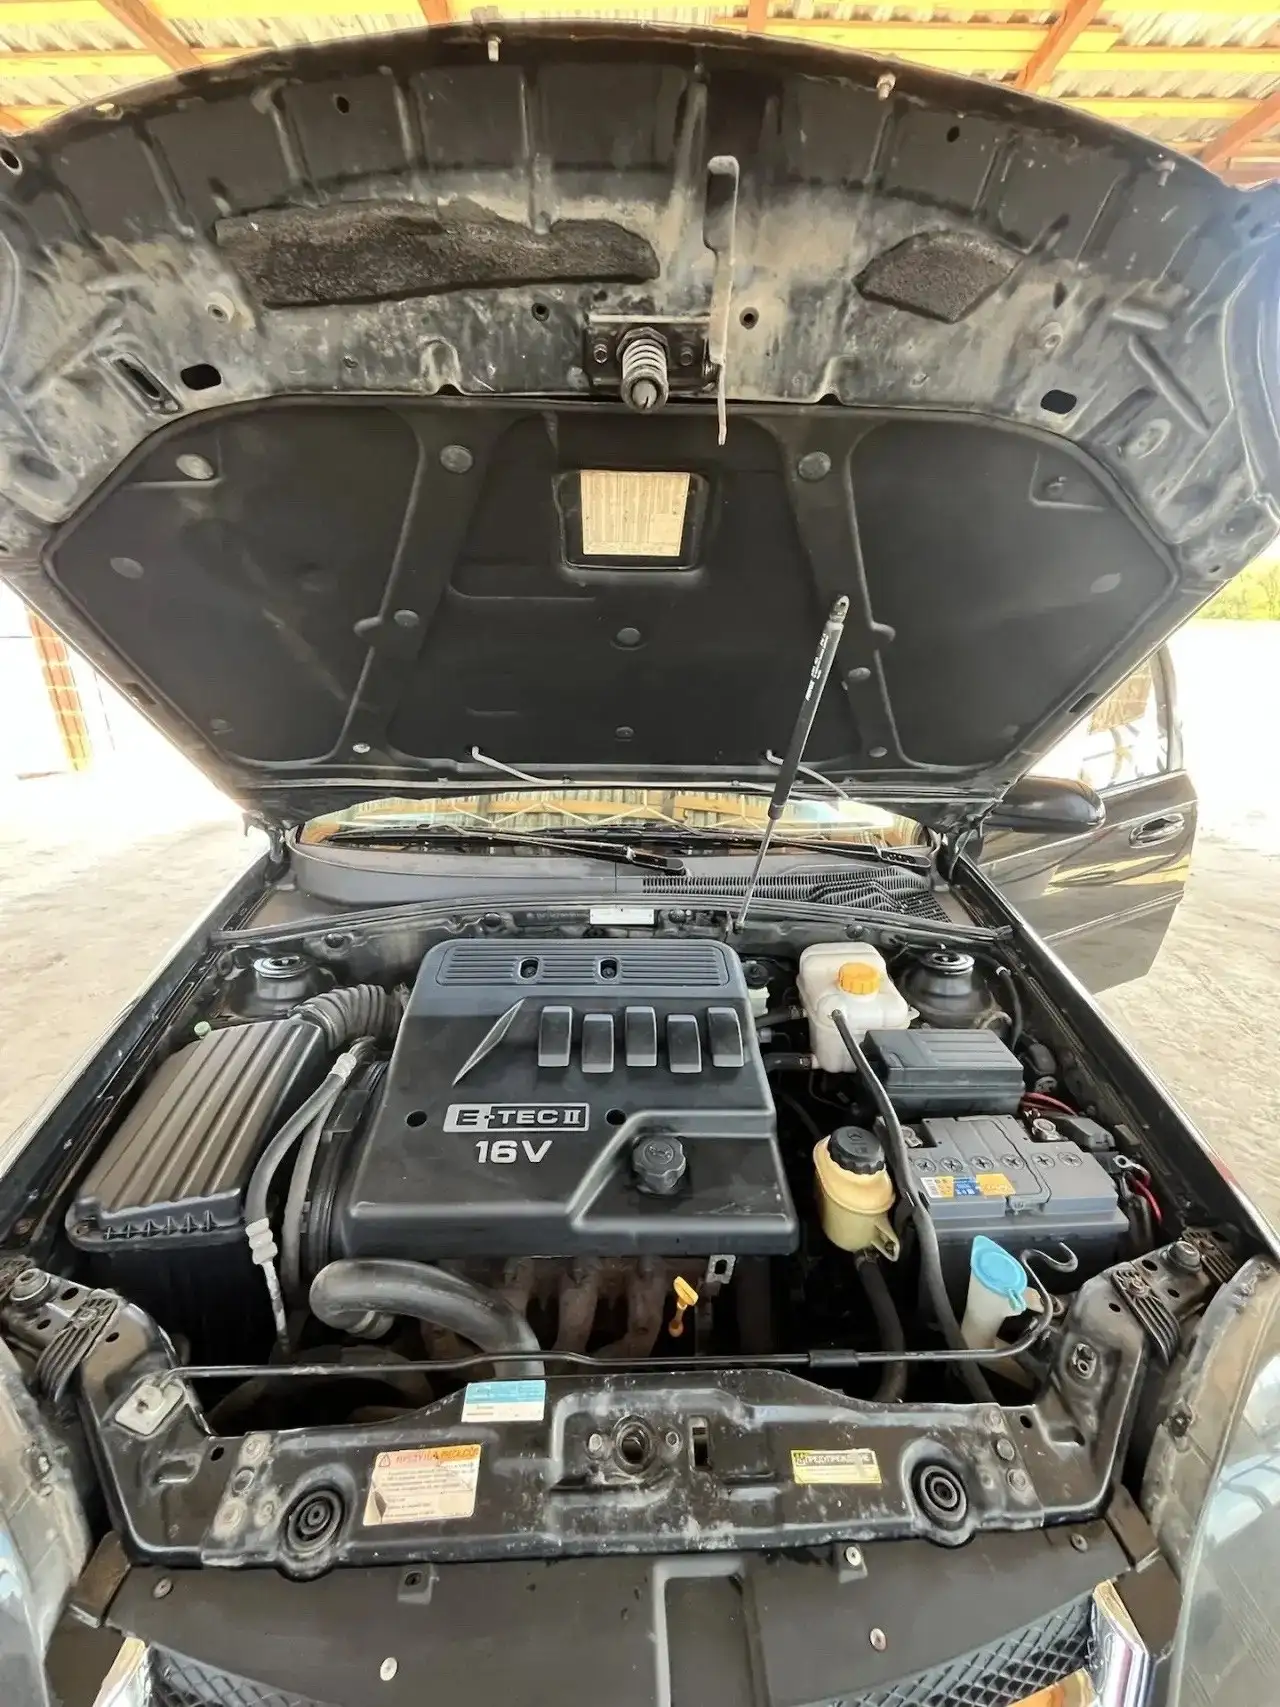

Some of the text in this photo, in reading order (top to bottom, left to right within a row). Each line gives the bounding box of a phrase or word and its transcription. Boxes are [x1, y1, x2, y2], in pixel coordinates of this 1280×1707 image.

[456, 1109, 582, 1126] E-TEC II
[475, 1139, 553, 1164] 16V
